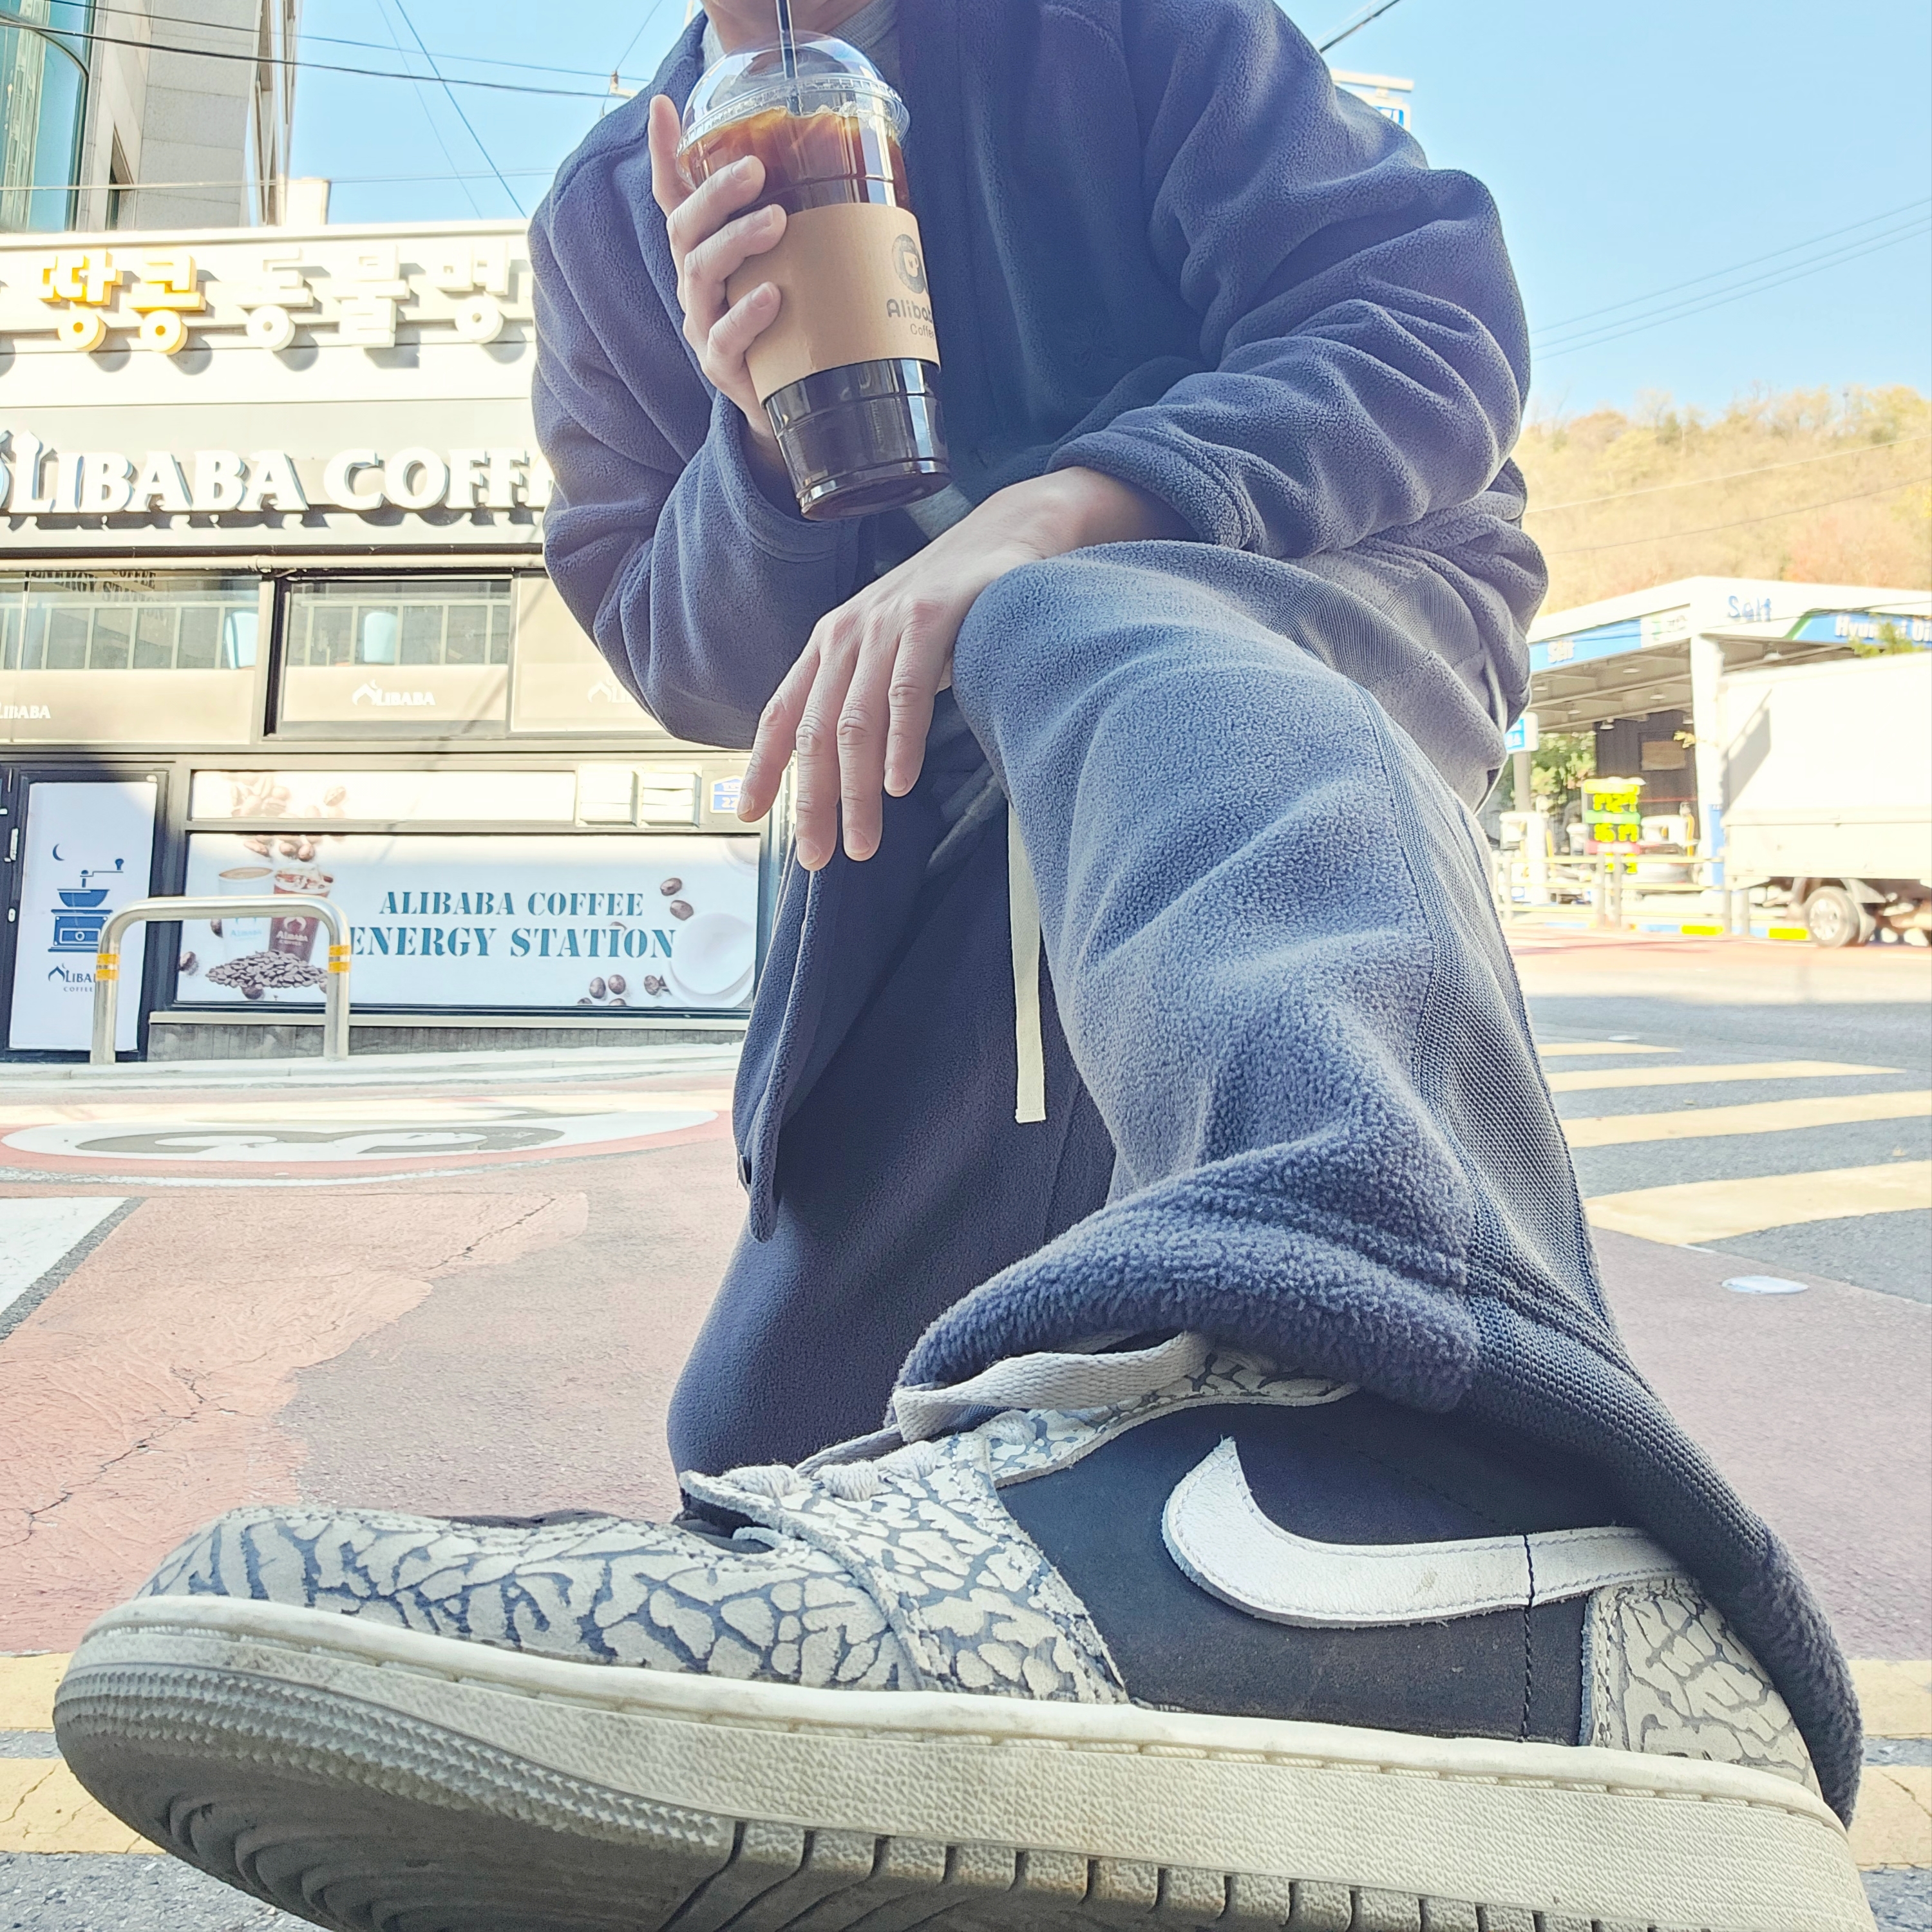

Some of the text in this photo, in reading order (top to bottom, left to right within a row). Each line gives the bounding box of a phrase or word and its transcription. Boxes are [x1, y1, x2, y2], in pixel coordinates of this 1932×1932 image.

[909, 323, 935, 340] Coffe
[379, 891, 644, 916] ALIBABA COFFEE
[350, 927, 677, 958] ENERGY STATION
